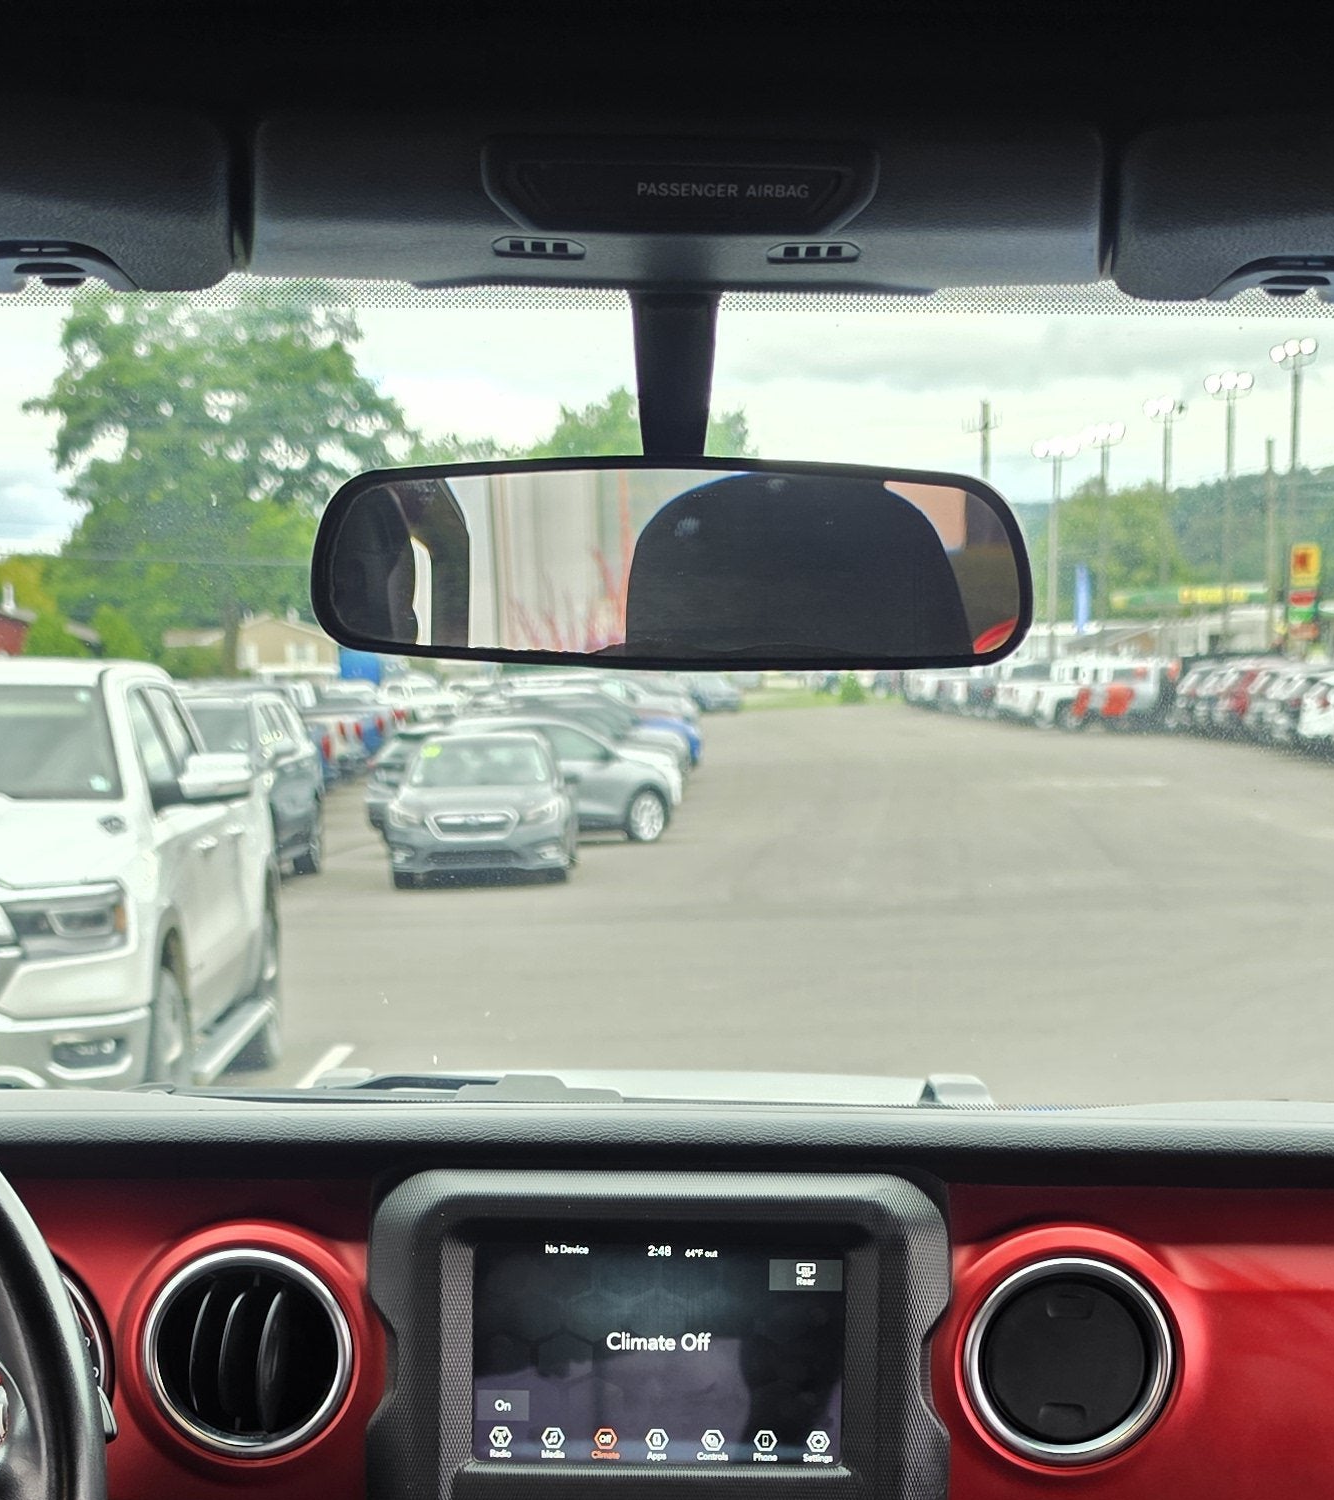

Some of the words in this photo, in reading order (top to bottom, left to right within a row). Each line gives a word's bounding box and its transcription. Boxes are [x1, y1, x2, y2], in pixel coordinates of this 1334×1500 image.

[637, 182, 738, 198] PASSENGER
[746, 183, 810, 199] AIRBAG
[545, 1244, 559, 1254] No
[560, 1244, 589, 1255] Device
[647, 1245, 672, 1257] 2:48
[606, 1332, 676, 1352] Climate
[680, 1333, 711, 1352] Off
[494, 1400, 512, 1412] On
[646, 1451, 667, 1461] Apps
[696, 1452, 729, 1461] Controls
[753, 1453, 778, 1462] Phone
[802, 1453, 833, 1464] Settings
